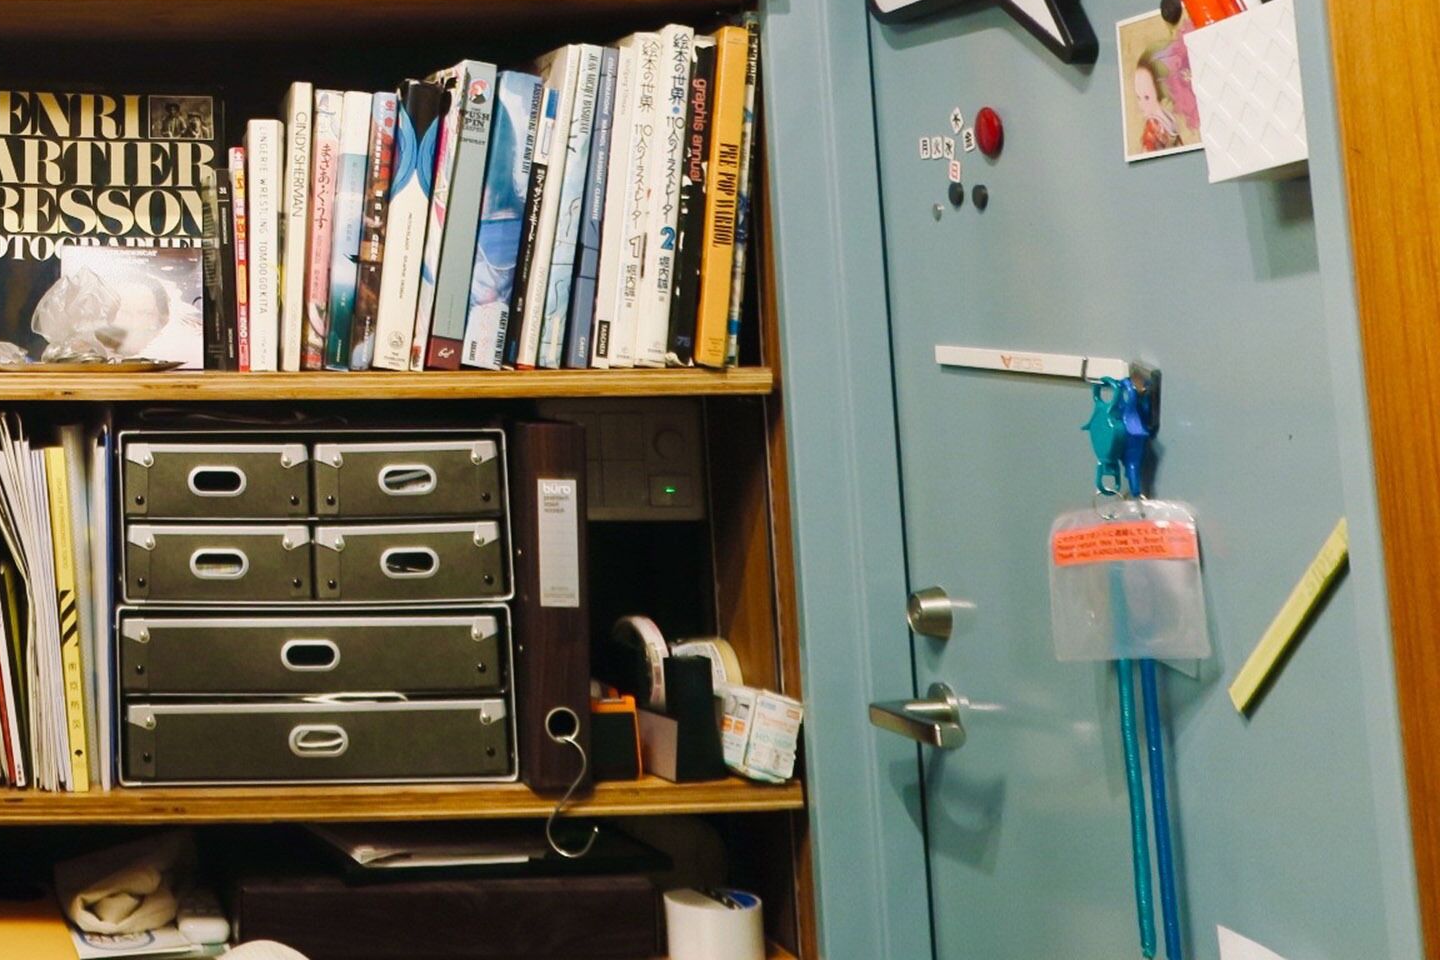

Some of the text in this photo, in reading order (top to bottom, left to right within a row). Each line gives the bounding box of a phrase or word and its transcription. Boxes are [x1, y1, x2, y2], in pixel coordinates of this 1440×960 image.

[639, 41, 660, 112] 絵本の世界
[668, 33, 691, 106] 絵本の世界
[258, 126, 268, 172] LINGERIE
[291, 112, 308, 218] CINDY SHERMAN
[689, 78, 708, 182] graphis annual
[258, 178, 269, 234] WRESTLING
[713, 142, 739, 248] PRE POP WARHOL
[659, 226, 676, 250] 2
[600, 324, 608, 356] TASCHEN
